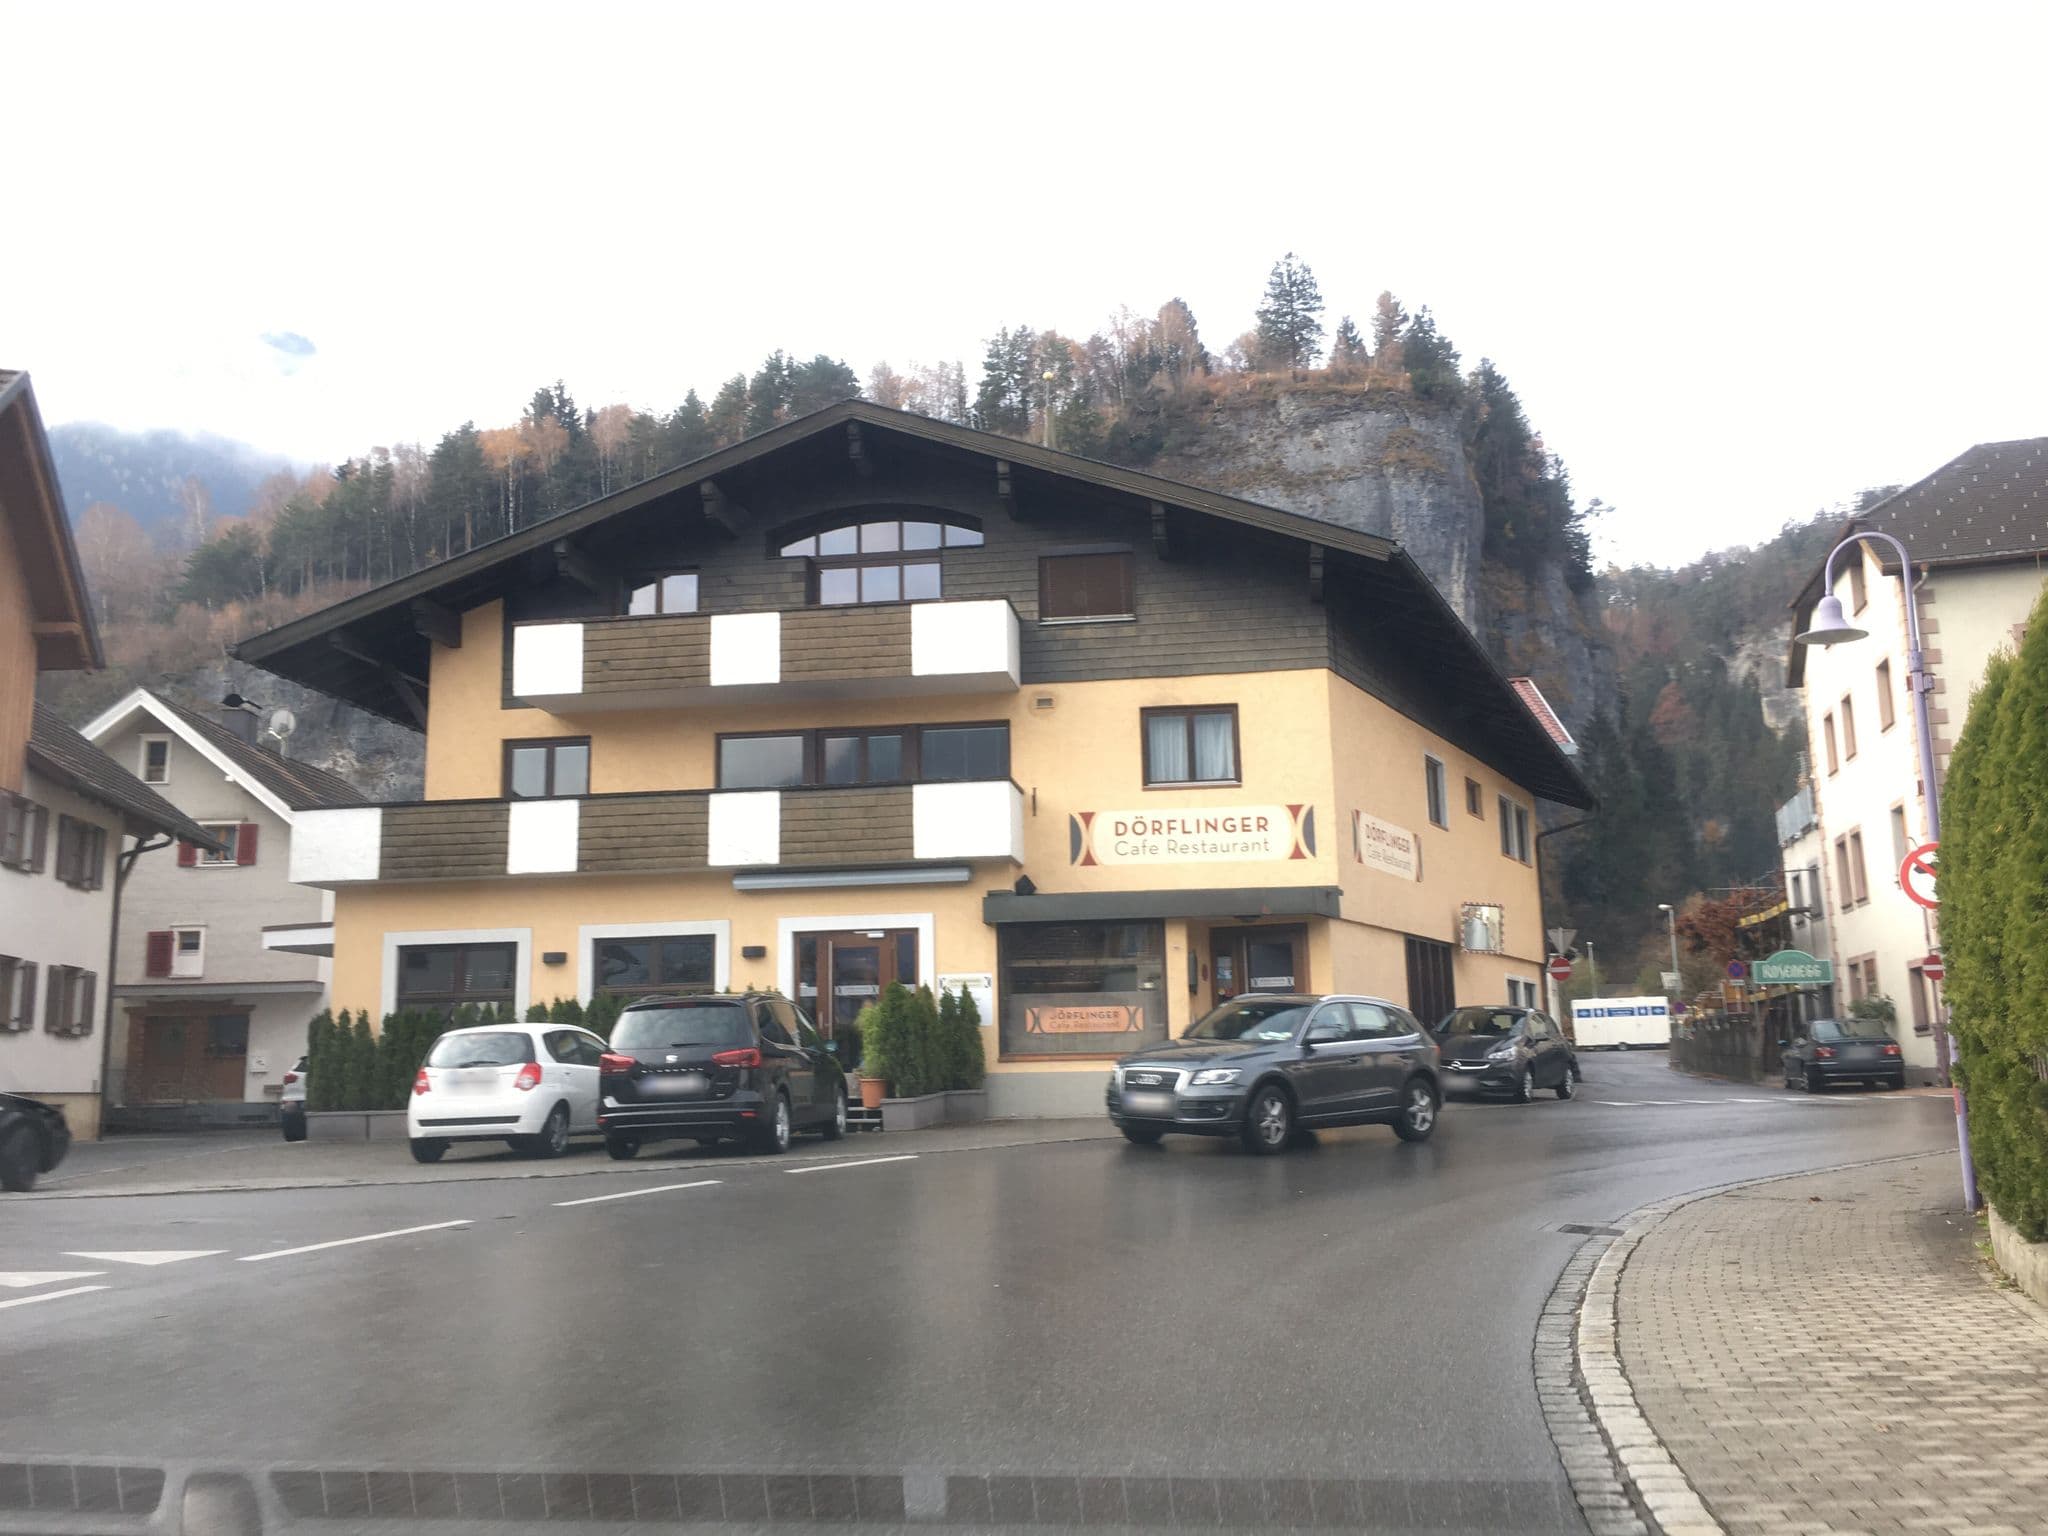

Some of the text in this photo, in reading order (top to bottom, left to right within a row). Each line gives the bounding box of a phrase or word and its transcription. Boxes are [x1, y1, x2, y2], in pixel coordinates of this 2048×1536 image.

[1114, 816, 1269, 837] DÖRFLINGER
[1114, 837, 1270, 857] Cafe Restaurant
